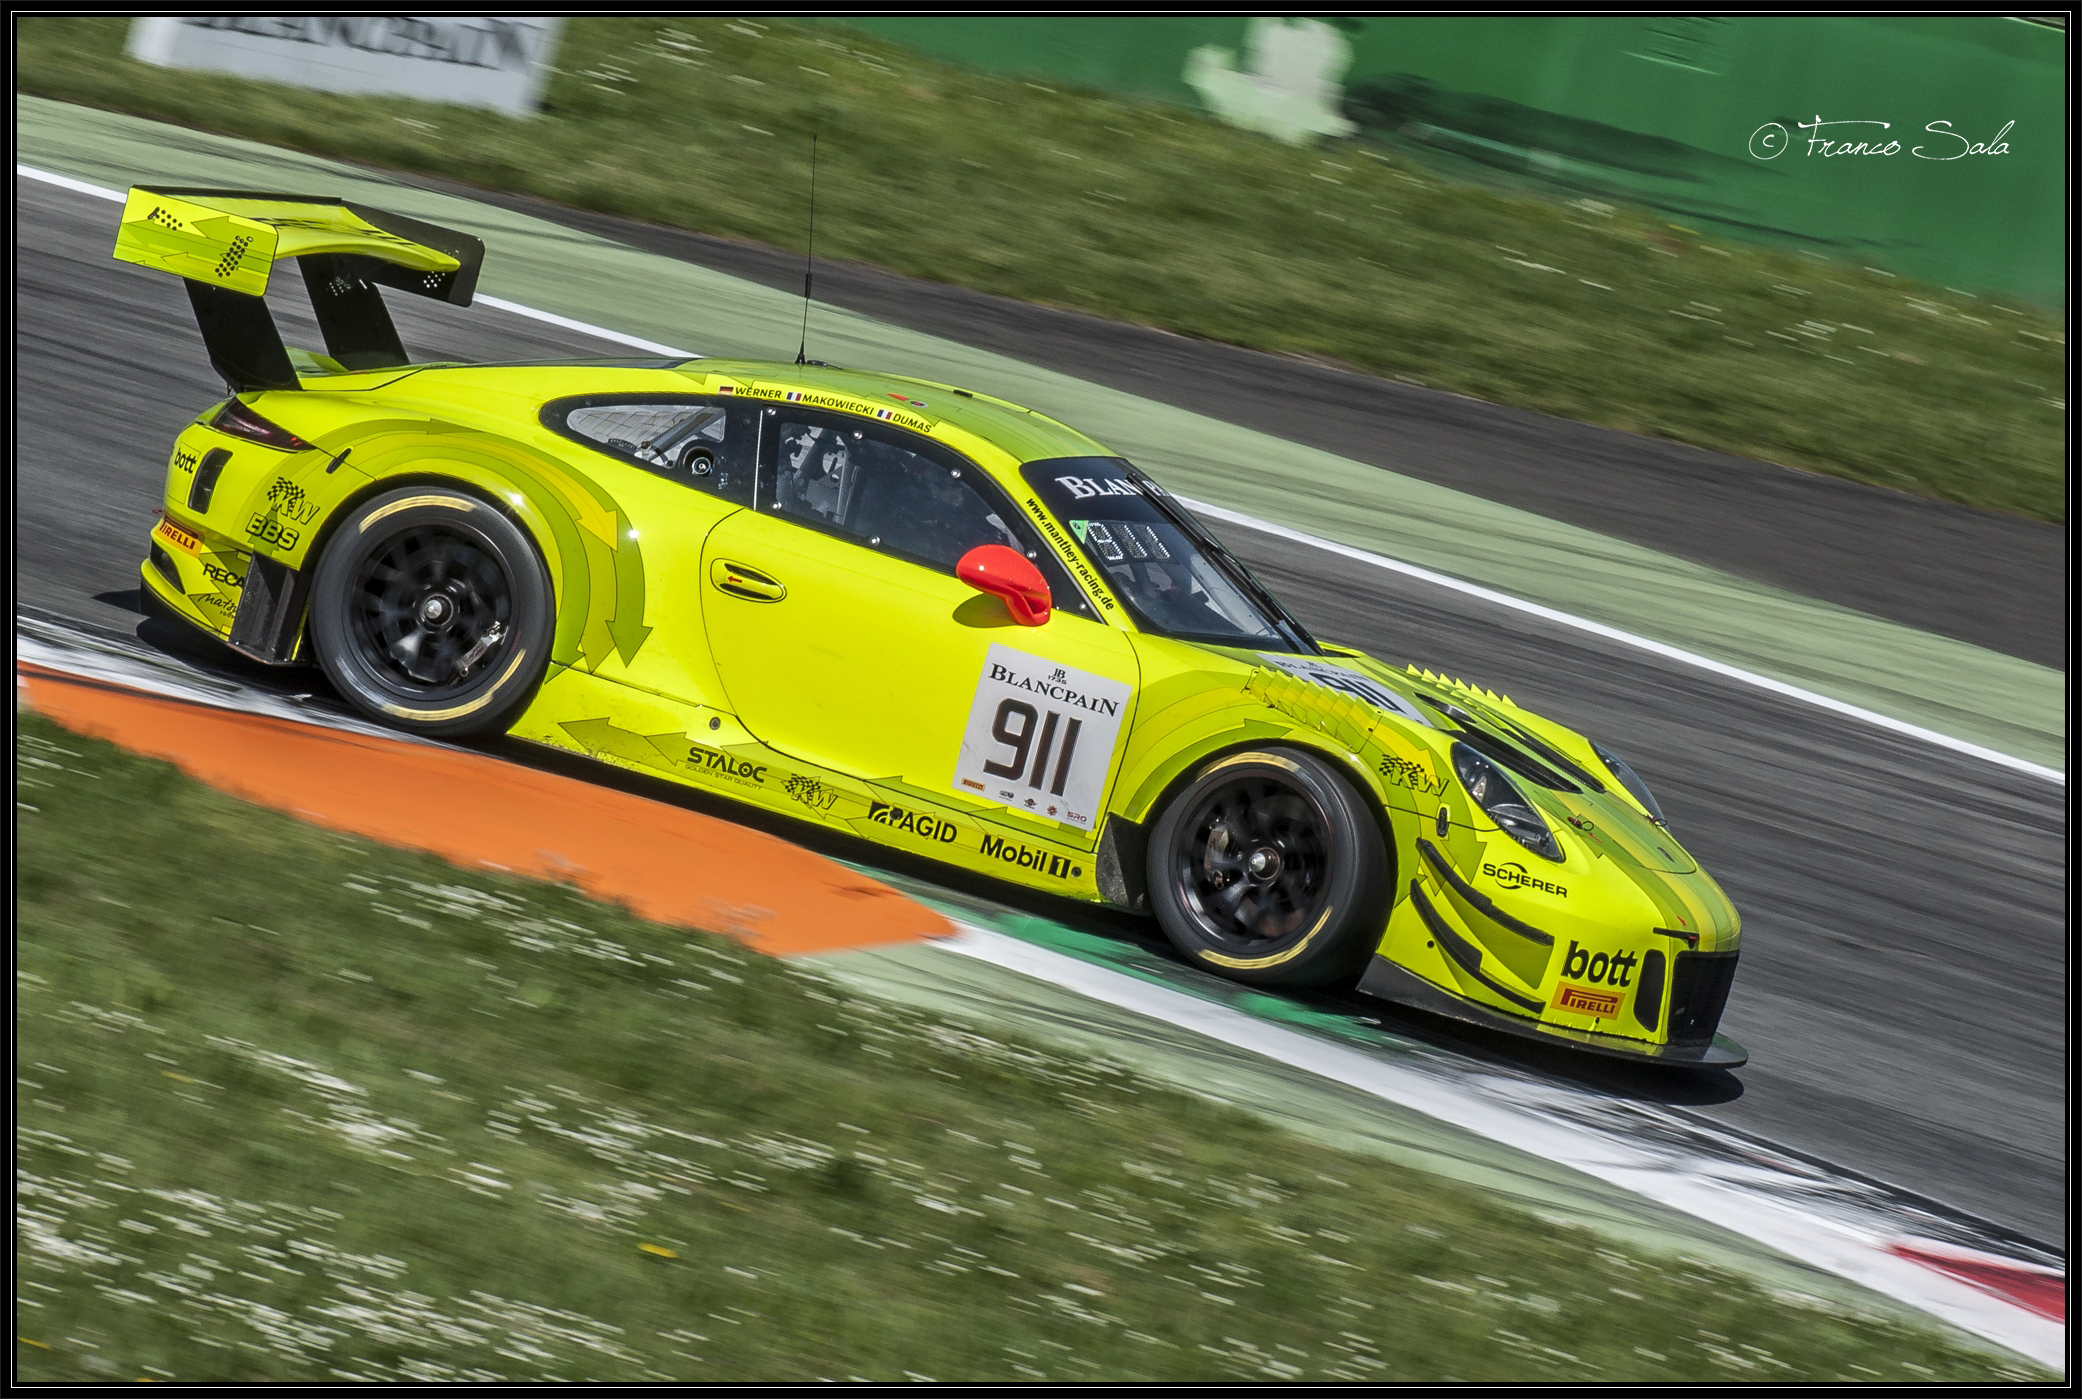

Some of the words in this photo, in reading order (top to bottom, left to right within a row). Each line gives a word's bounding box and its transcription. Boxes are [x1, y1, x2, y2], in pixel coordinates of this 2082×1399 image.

[735, 386, 782, 399] WERNER
[802, 394, 874, 416] MAKOWIECKI
[892, 414, 932, 433] DUMAS
[174, 446, 197, 475] bott
[271, 491, 321, 526] KW
[245, 511, 301, 552] BBS
[1025, 497, 1115, 611] www.manthey-racing.de
[988, 662, 1120, 717] BLANCPAIN
[687, 746, 768, 783] STALOC
[983, 697, 1083, 798] 911
[684, 764, 713, 776] GOLDEN
[714, 771, 733, 782] STAR
[733, 778, 763, 790] QUALITY
[1389, 765, 1450, 797] KW
[888, 806, 958, 843] PAGID
[980, 834, 1048, 872] Mobil
[1482, 863, 1568, 898] SCHERER
[1560, 940, 1638, 988] bott
[1560, 988, 1619, 1015] PIRELLI
